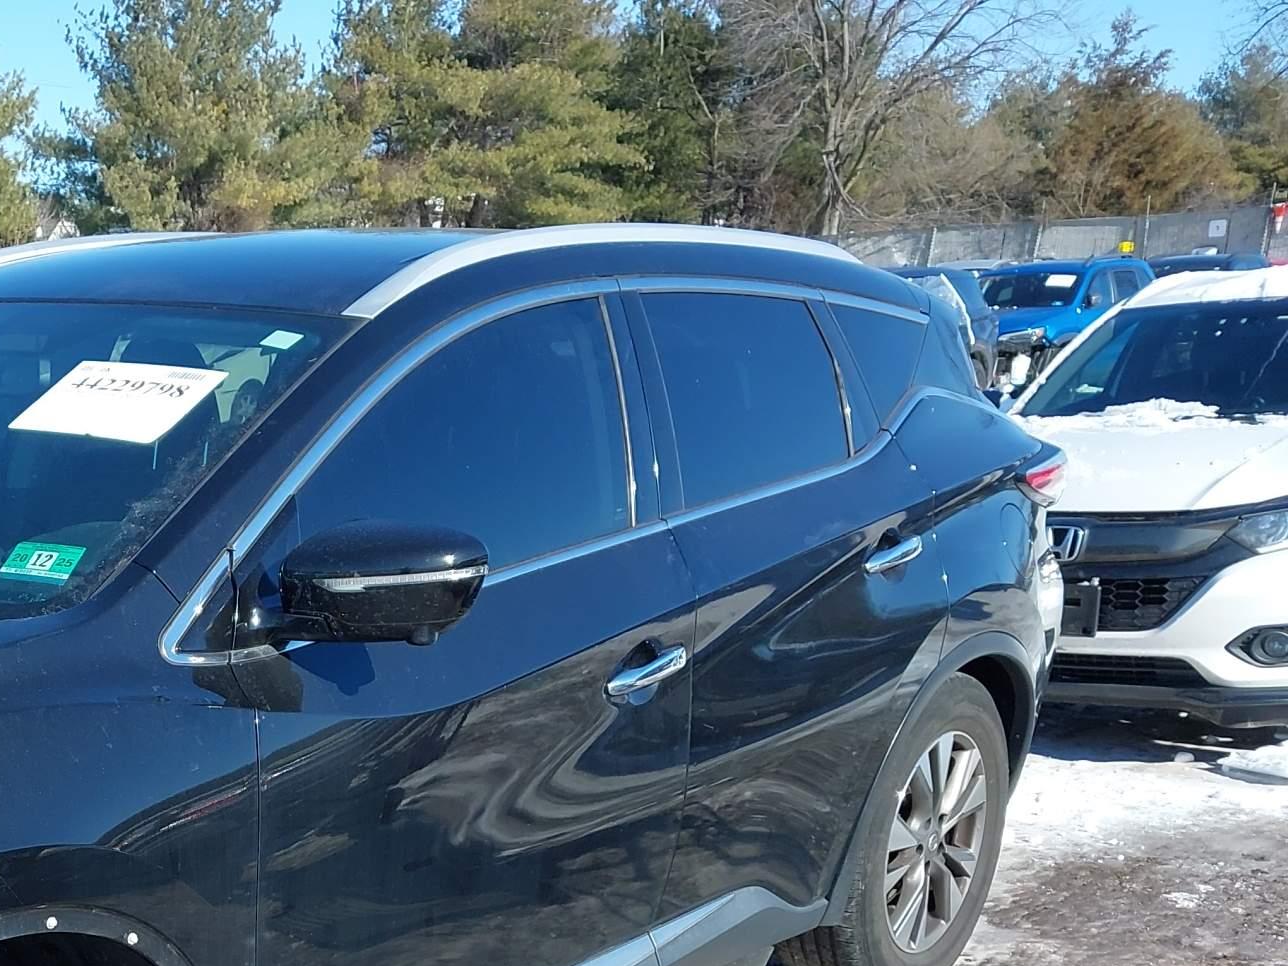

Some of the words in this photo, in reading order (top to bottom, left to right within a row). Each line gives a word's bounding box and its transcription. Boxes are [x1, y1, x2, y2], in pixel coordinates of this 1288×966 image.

[71, 377, 190, 398] 44229798
[13, 553, 28, 562] 20
[30, 553, 54, 567] 12
[56, 558, 74, 567] 25
